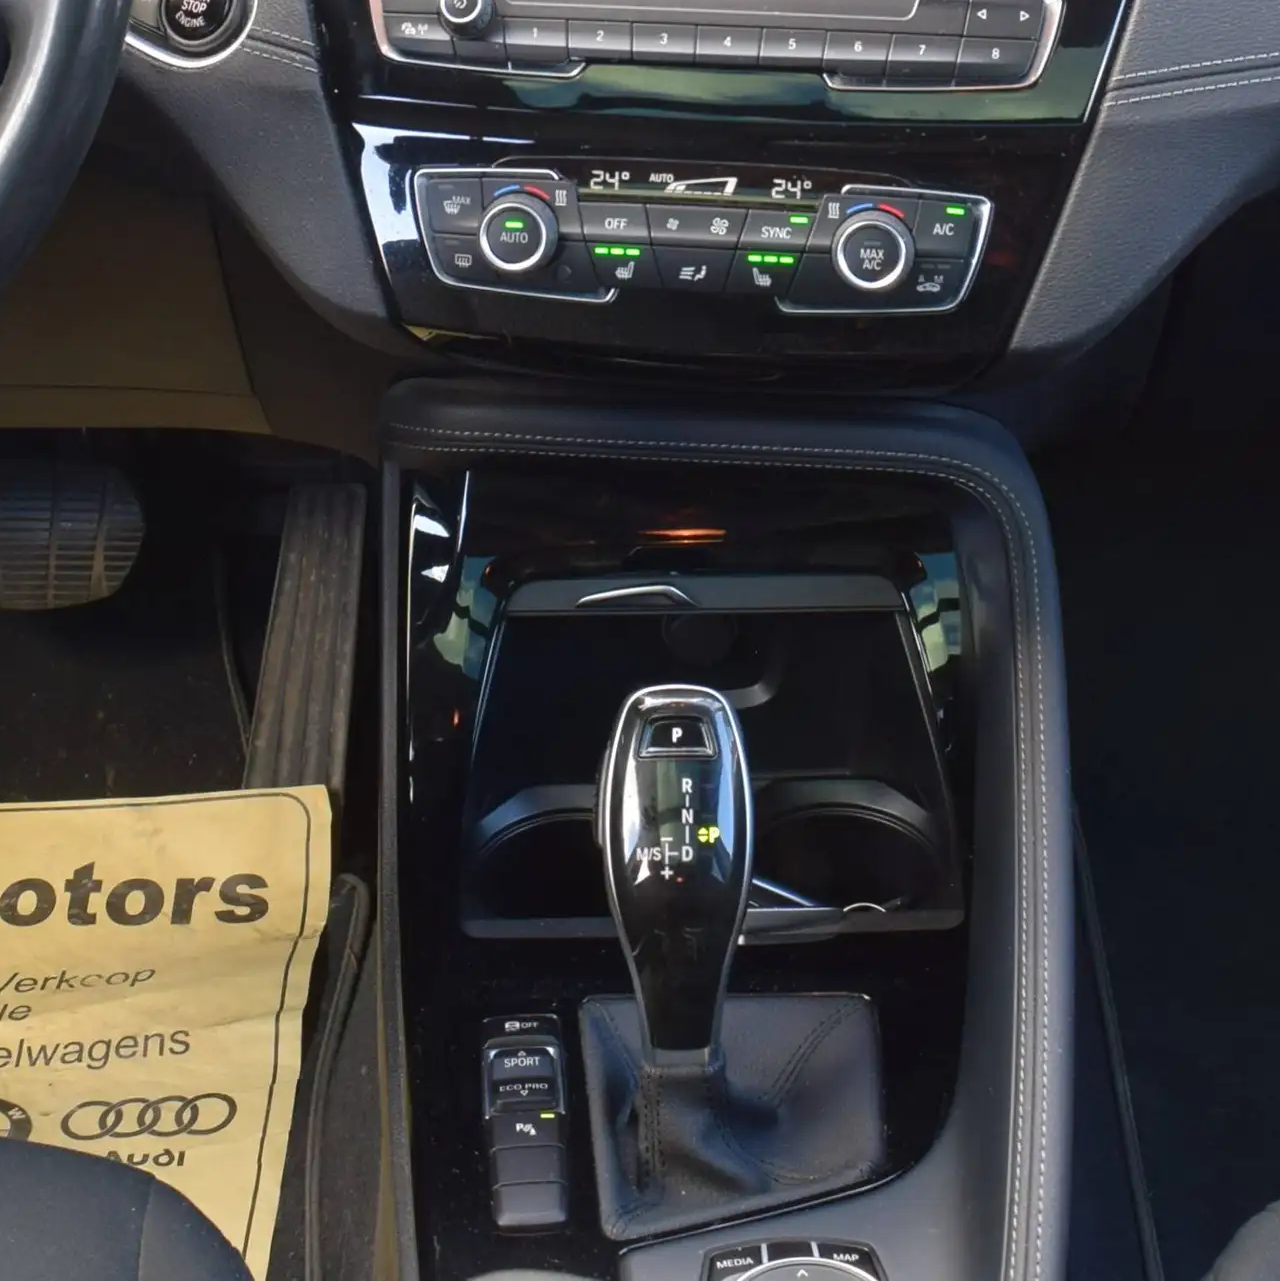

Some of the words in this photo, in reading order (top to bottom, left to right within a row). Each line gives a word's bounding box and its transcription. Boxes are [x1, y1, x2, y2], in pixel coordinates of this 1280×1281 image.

[181, 0, 208, 13] STOP
[175, 11, 206, 28] ENGINE
[532, 27, 538, 38] 1
[596, 30, 604, 42] 2
[659, 33, 668, 44] 3
[723, 36, 731, 47] 4
[788, 38, 796, 50] 5
[854, 41, 863, 52] 6
[919, 44, 927, 55] 7
[991, 48, 1001, 59] 8
[649, 173, 674, 183] AUTO
[605, 218, 628, 230] OFF
[932, 223, 954, 236] A/C
[500, 231, 528, 244] AUTO
[760, 226, 793, 239] SYNC
[860, 249, 885, 260] MAX
[862, 259, 882, 271] A/C
[672, 727, 683, 743] P
[681, 778, 692, 793] R
[681, 808, 694, 824] N
[709, 827, 720, 843] P
[636, 847, 662, 861] M/S
[681, 846, 693, 862] D
[504, 1057, 540, 1068] SPORT
[499, 1084, 522, 1092] ECO
[525, 1082, 549, 1090] PRO
[716, 1256, 754, 1270] MEDIA
[833, 1252, 859, 1263] MAP
